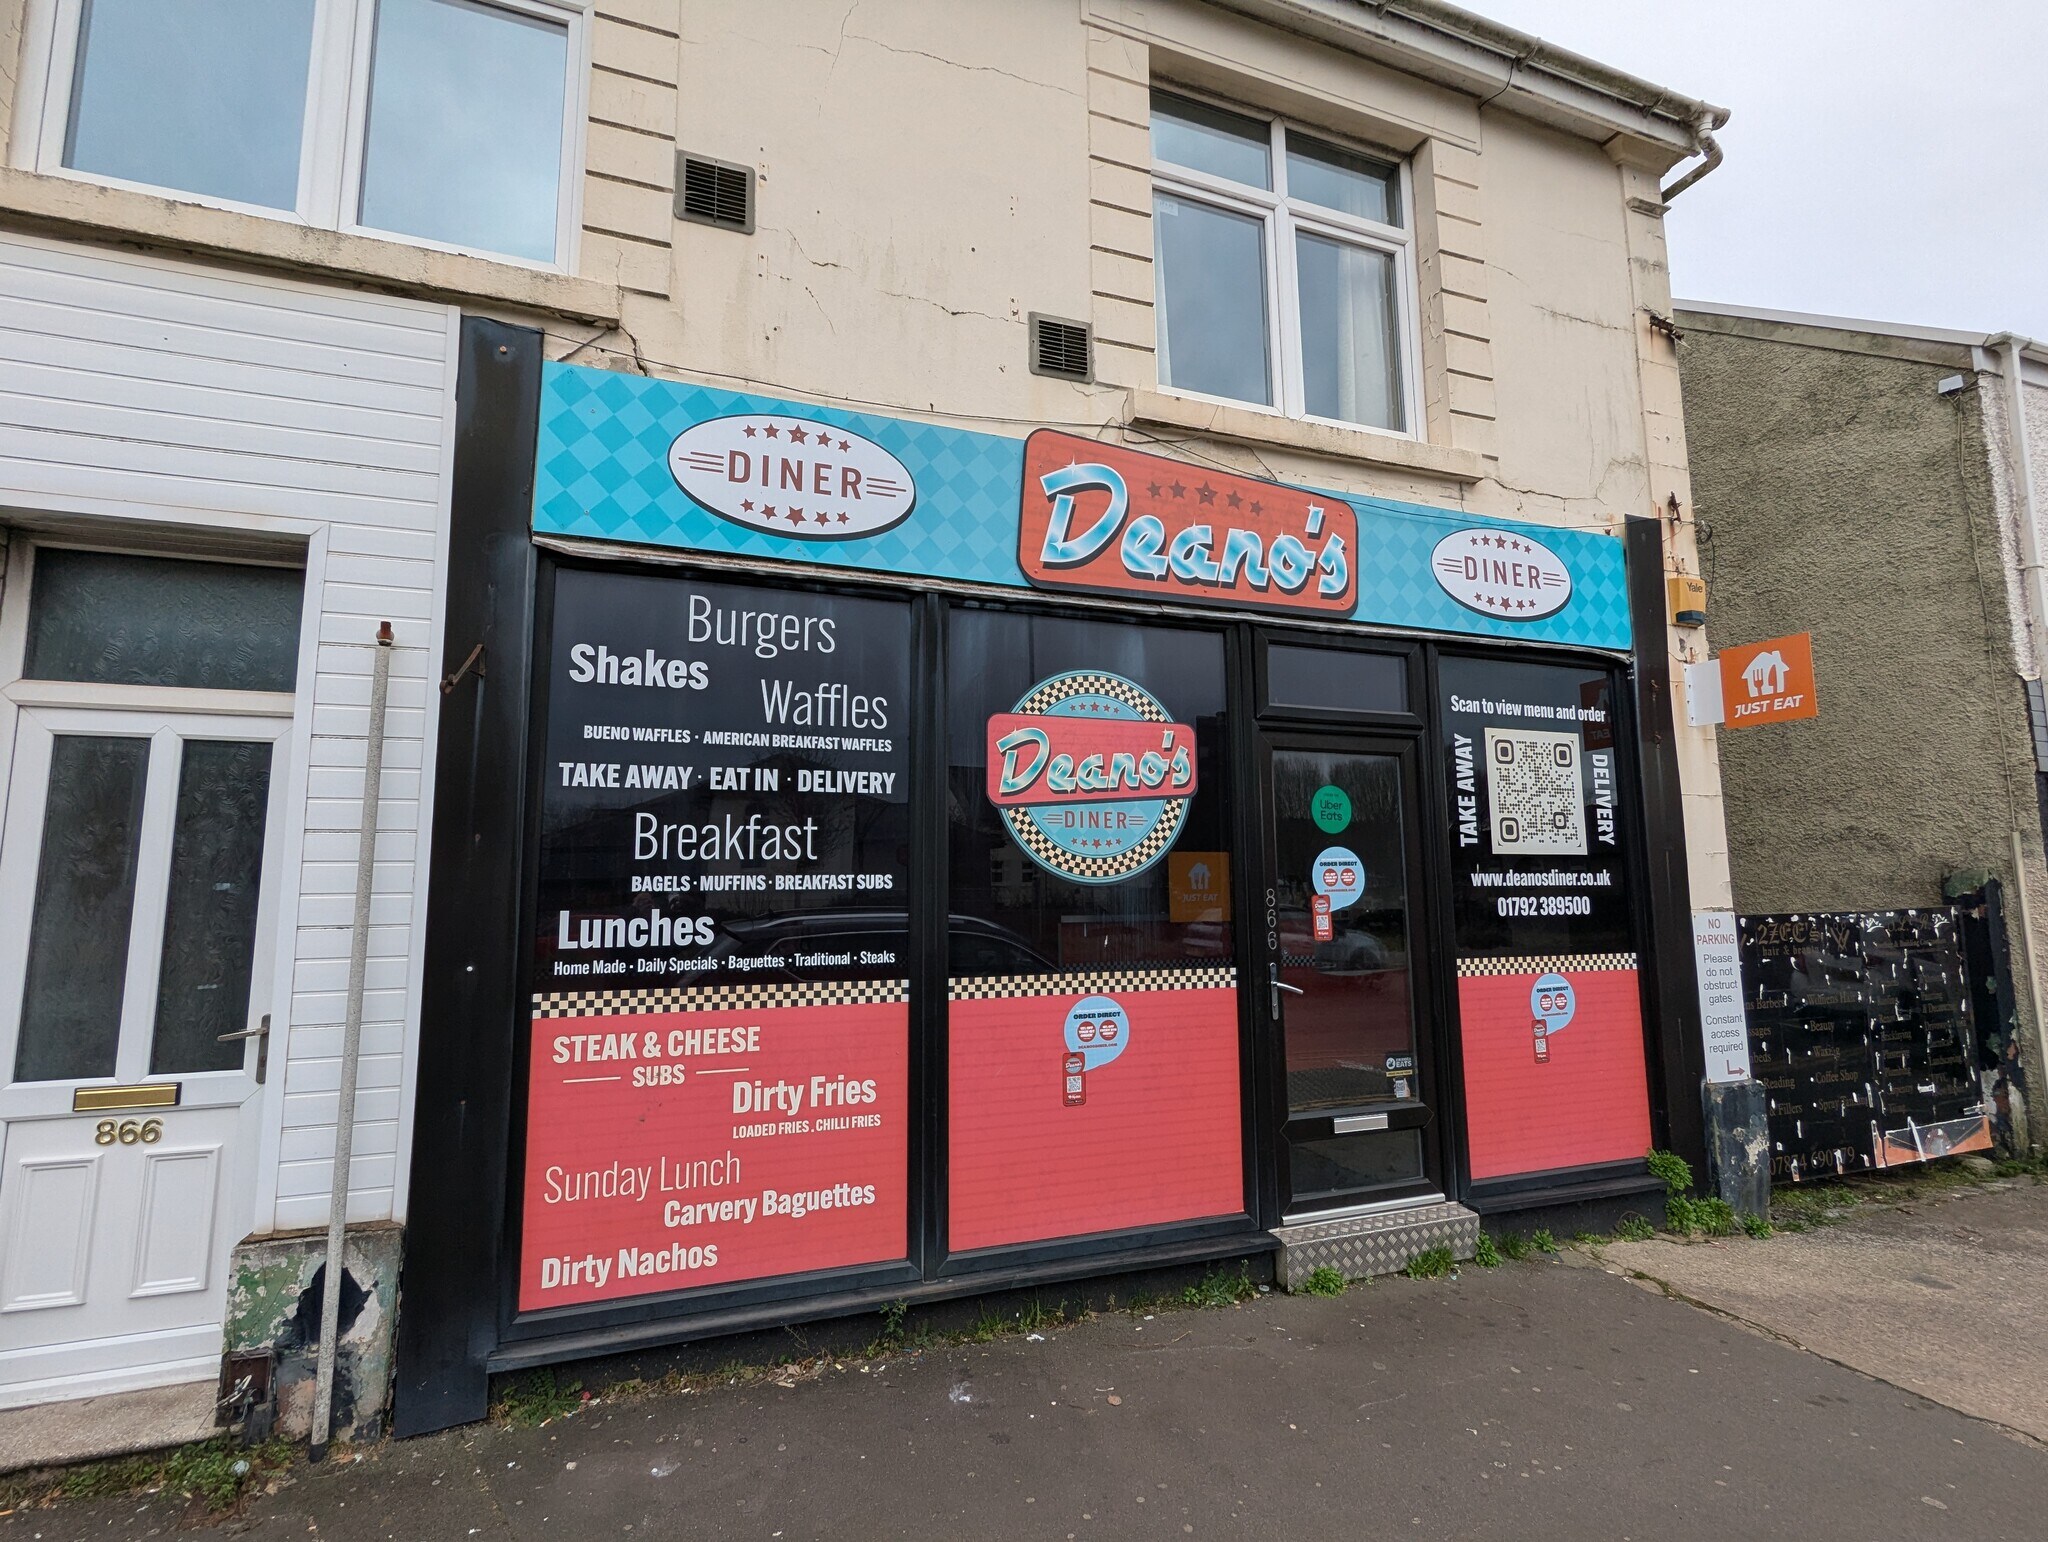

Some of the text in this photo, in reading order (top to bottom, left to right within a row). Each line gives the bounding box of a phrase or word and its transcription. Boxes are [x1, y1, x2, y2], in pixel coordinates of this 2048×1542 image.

[729, 450, 862, 500] DINER
[1039, 460, 1348, 594] Deano's
[1464, 556, 1542, 590] DINER
[1686, 582, 1703, 593] Yale
[688, 594, 836, 659] Burgers
[569, 643, 709, 690] Shakes
[761, 679, 888, 730] Waffles
[1451, 695, 1606, 723] Scan to view menu and order
[1734, 695, 1804, 718] JUST EAT
[584, 725, 892, 752] BUENO WAFFLES AMERICAN BREAKFAST WAFFLES
[996, 726, 1191, 794] Deano's
[559, 762, 896, 794] TAKE AWAY EAT IN DELIVERY
[1454, 733, 1478, 847] TAKE AWAY
[1320, 800, 1343, 810] Uber
[1592, 754, 1615, 845] DELIVERY
[1064, 810, 1127, 829] DINER
[1320, 810, 1343, 821] Eats
[634, 812, 818, 861] Breakfast
[631, 874, 893, 892] BAGELS MUFFINS BREAKFAST SUBS
[1471, 869, 1611, 887] www.deanosdiner.co.uk
[1183, 893, 1218, 903] JUST EAT
[1498, 896, 1591, 917] 01792 389500
[558, 908, 715, 950] Lunches
[1708, 918, 1721, 929] NO
[1696, 933, 1735, 945] PARKING
[1762, 946, 1779, 957] hair
[554, 950, 895, 976] Home Made Daily Specials Baguettes Traditional Steaks
[1703, 953, 1733, 964] Please
[1706, 966, 1733, 977] do not
[1703, 980, 1738, 991] obstruct
[1708, 995, 1735, 1006] gates.
[1705, 1013, 1743, 1026] Constant
[552, 1026, 761, 1064] STEAK & CHEESE
[1710, 1028, 1740, 1039] access
[1709, 1041, 1744, 1055] required
[632, 1064, 685, 1087] SUBS
[732, 1074, 877, 1116] Dirty Fries
[95, 1117, 164, 1146] 866
[733, 1114, 881, 1139] LOADED FRIES CHILLI FRIES
[544, 1150, 741, 1204] Sunday Lunch
[664, 1183, 876, 1228] Carvery Baguettes
[541, 1242, 718, 1289] Dirty Nachos
